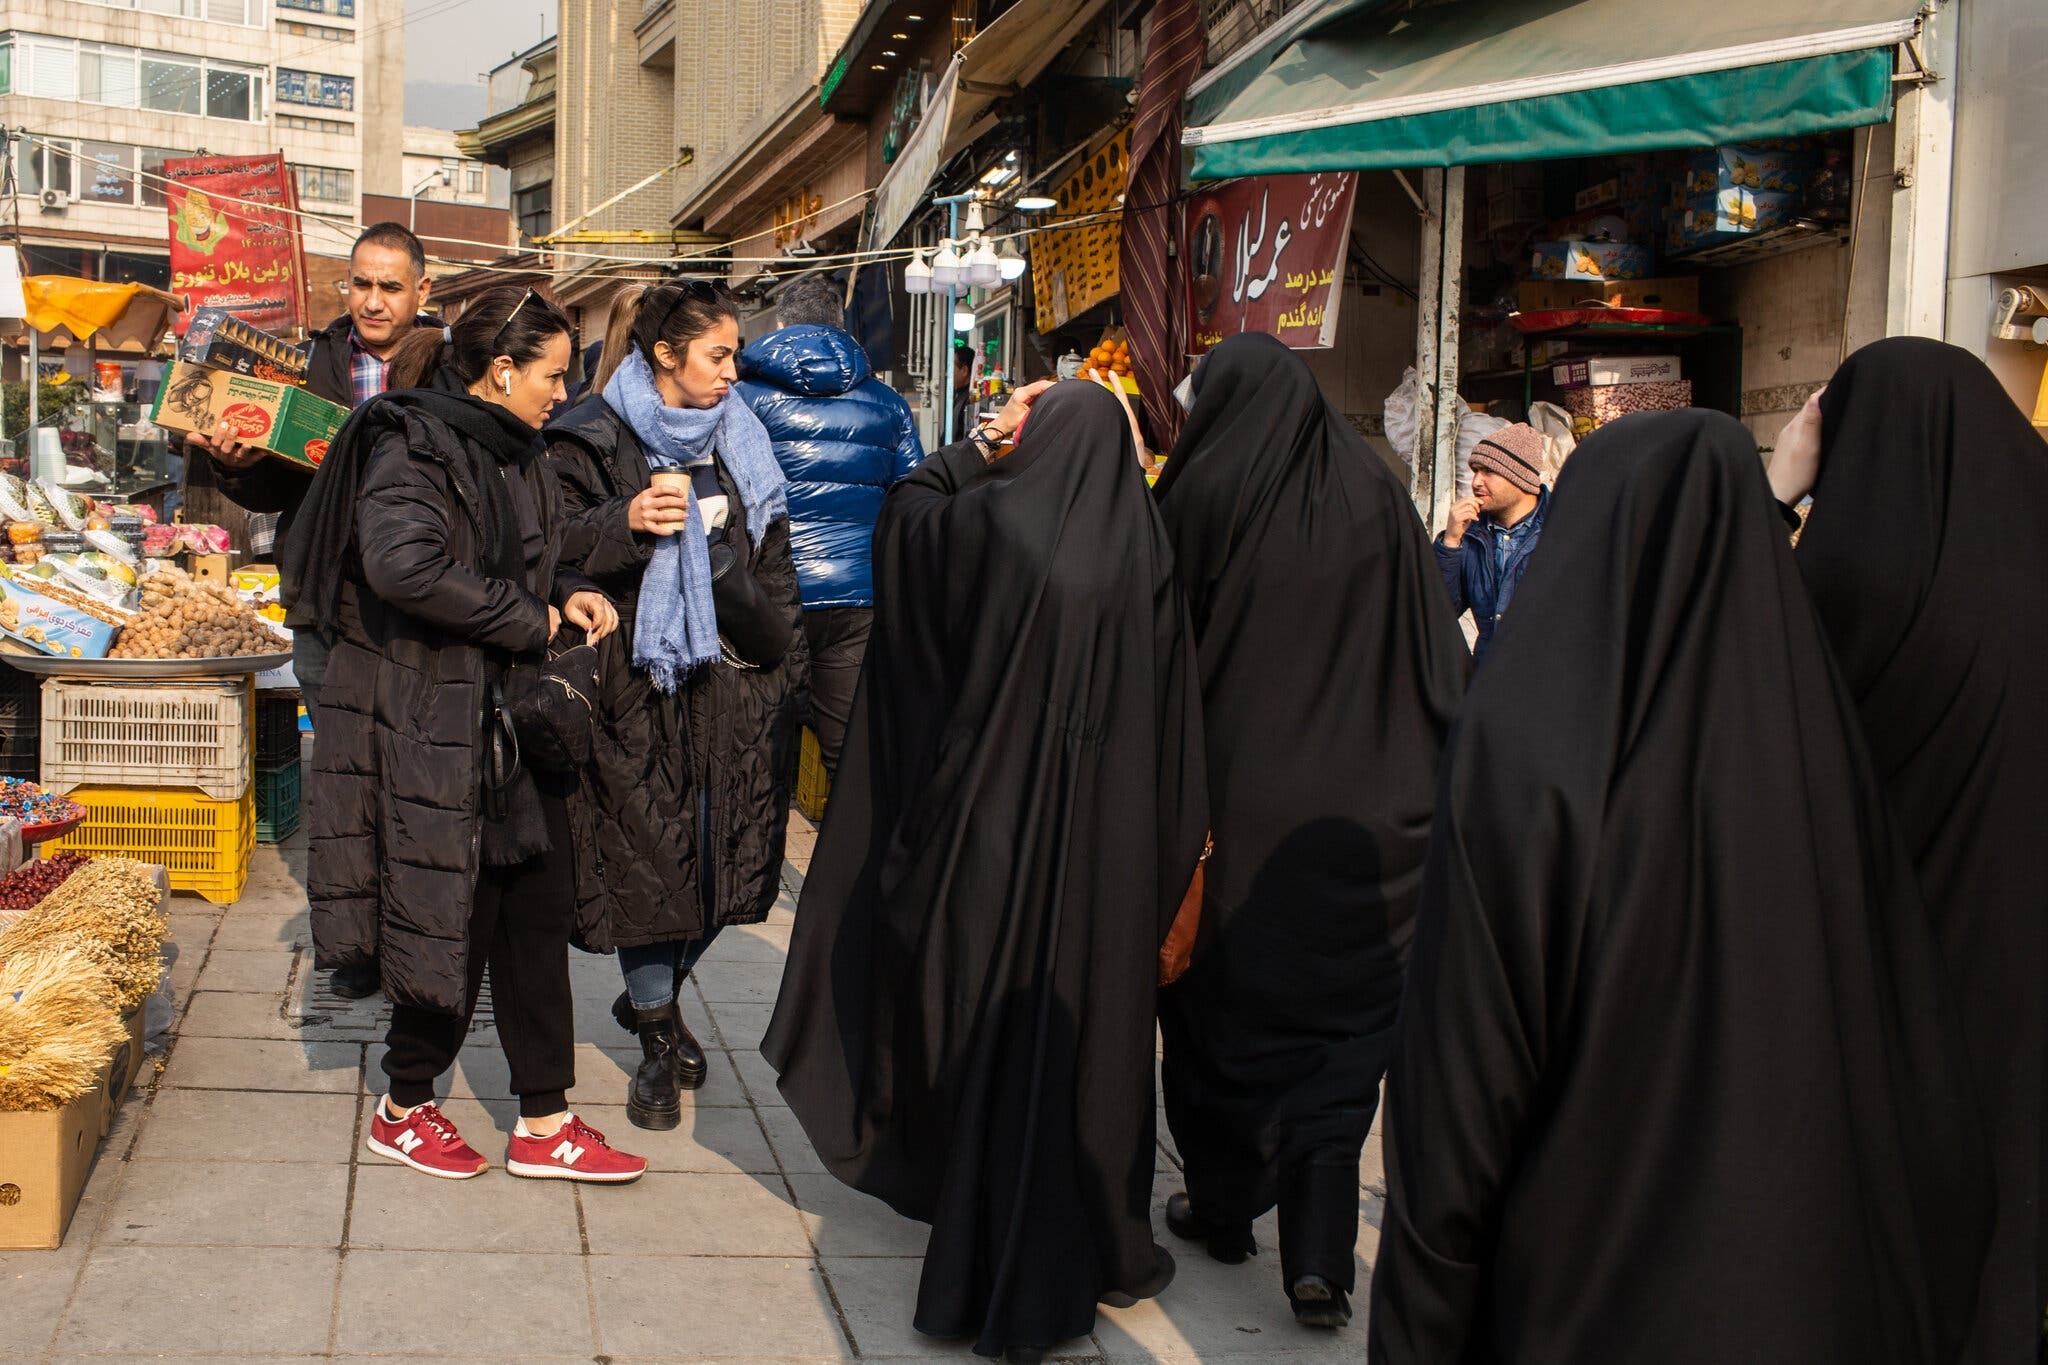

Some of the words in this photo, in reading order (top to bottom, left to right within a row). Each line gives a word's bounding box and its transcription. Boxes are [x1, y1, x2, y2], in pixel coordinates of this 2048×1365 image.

[253, 259, 294, 283] اولین
[1246, 219, 1292, 300] عمه
[172, 263, 216, 288] تنوری
[218, 260, 250, 285] بلال
[1277, 301, 1307, 334] گندم
[394, 1128, 423, 1154] N
[550, 1140, 586, 1165] N
